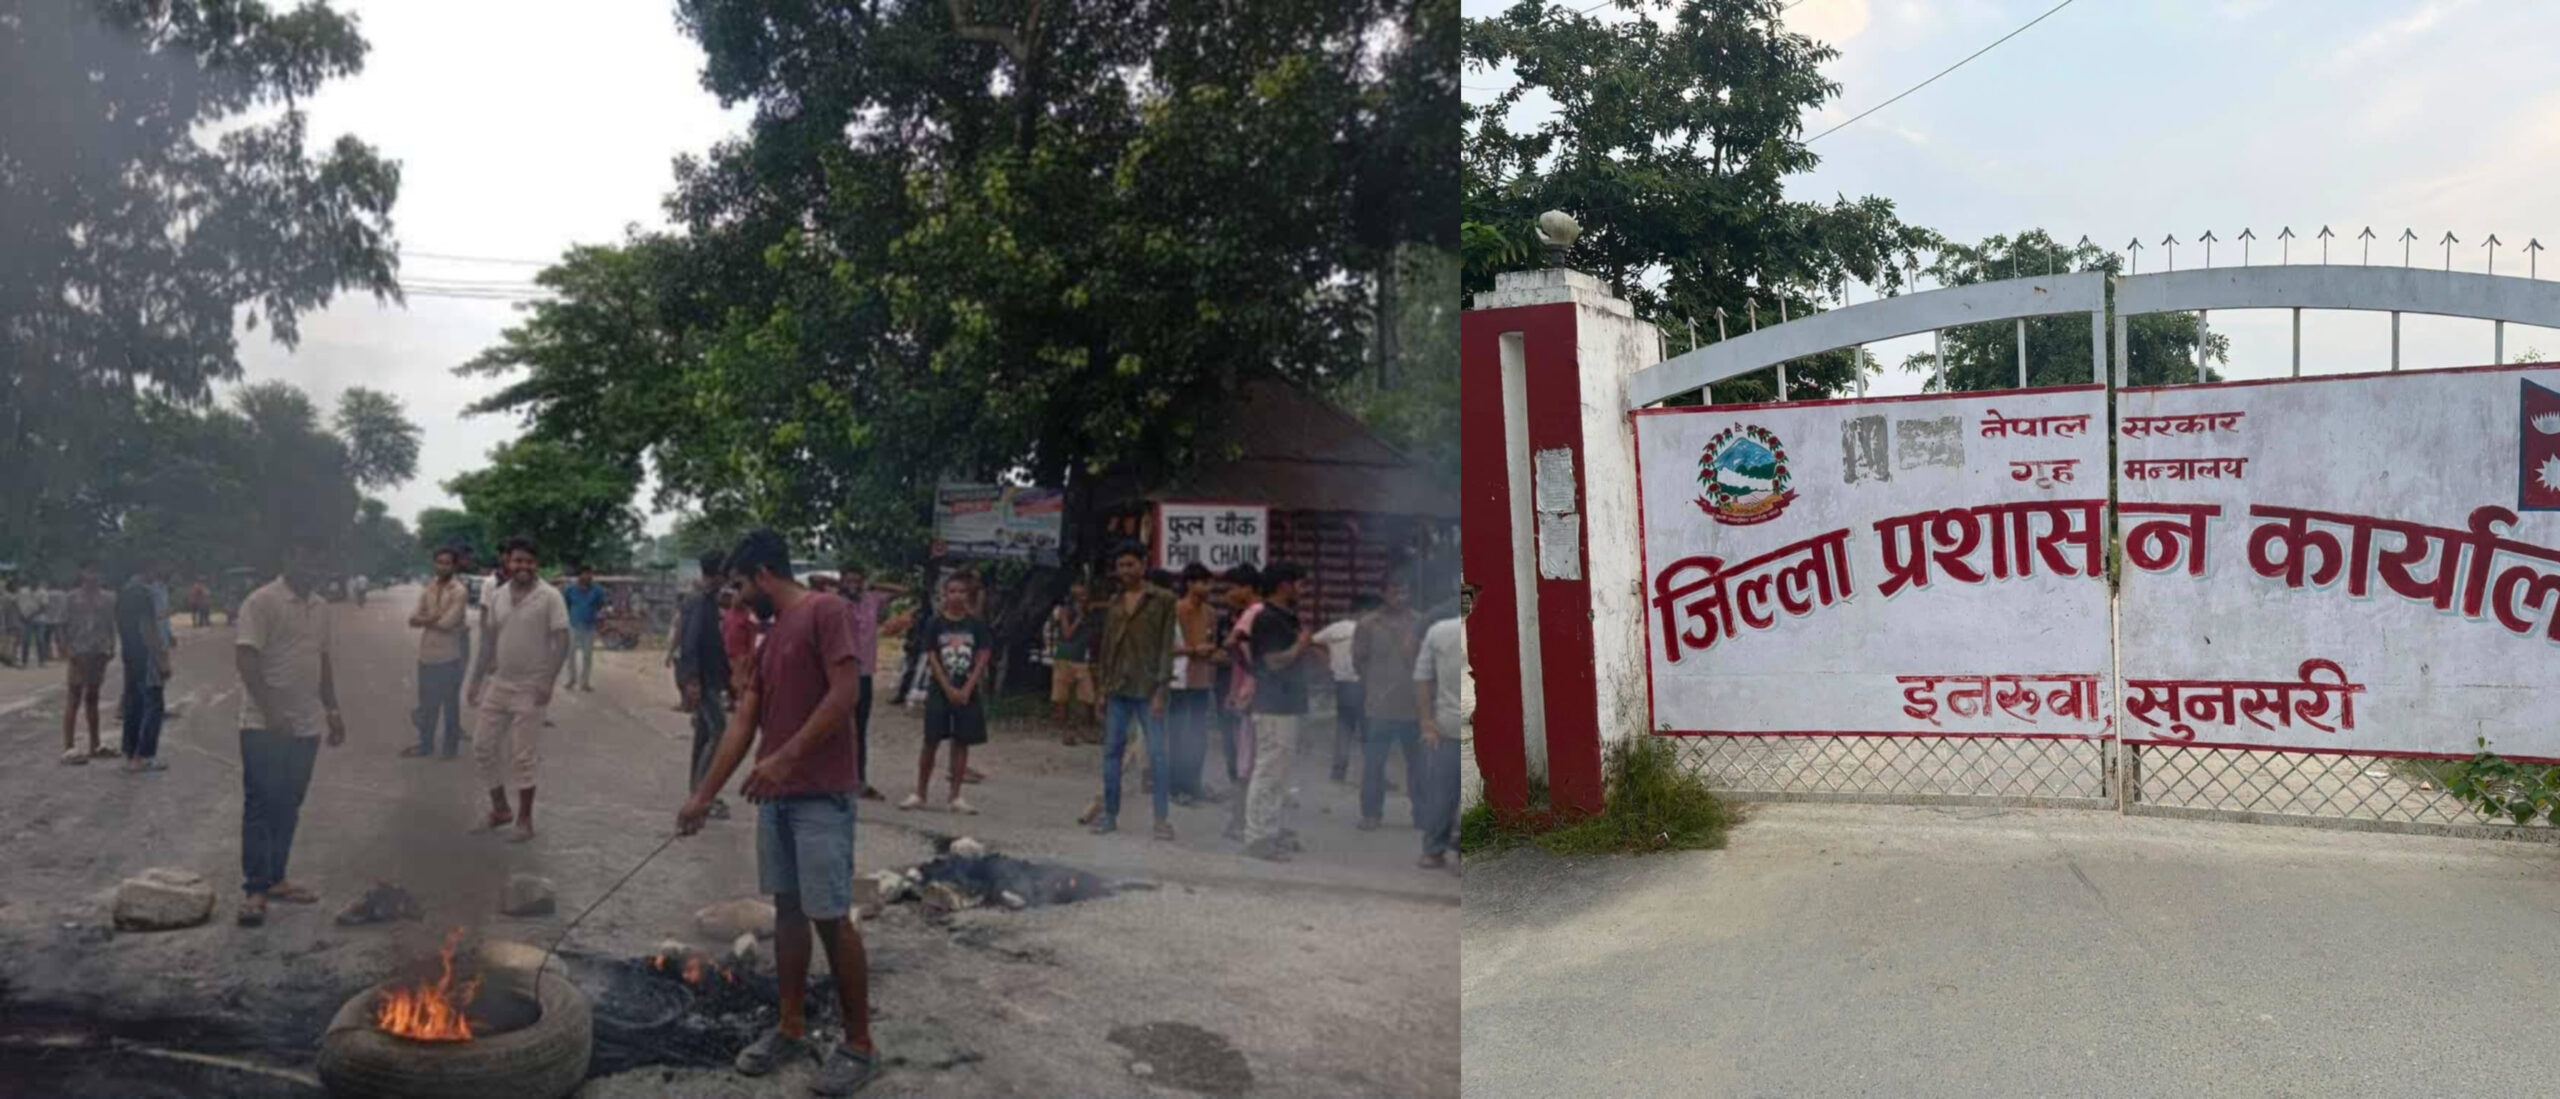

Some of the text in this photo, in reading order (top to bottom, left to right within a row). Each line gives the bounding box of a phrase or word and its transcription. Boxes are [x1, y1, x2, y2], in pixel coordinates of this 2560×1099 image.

[1981, 409, 2246, 439] नेपाल सरकार
[2010, 457, 2249, 489] गृह मन्त्रालय
[1214, 511, 1257, 536] चौक
[1210, 545, 1262, 565] CHAUK
[1652, 527, 1853, 664] जिल्ला
[2125, 658, 2367, 742] सुनसरी
